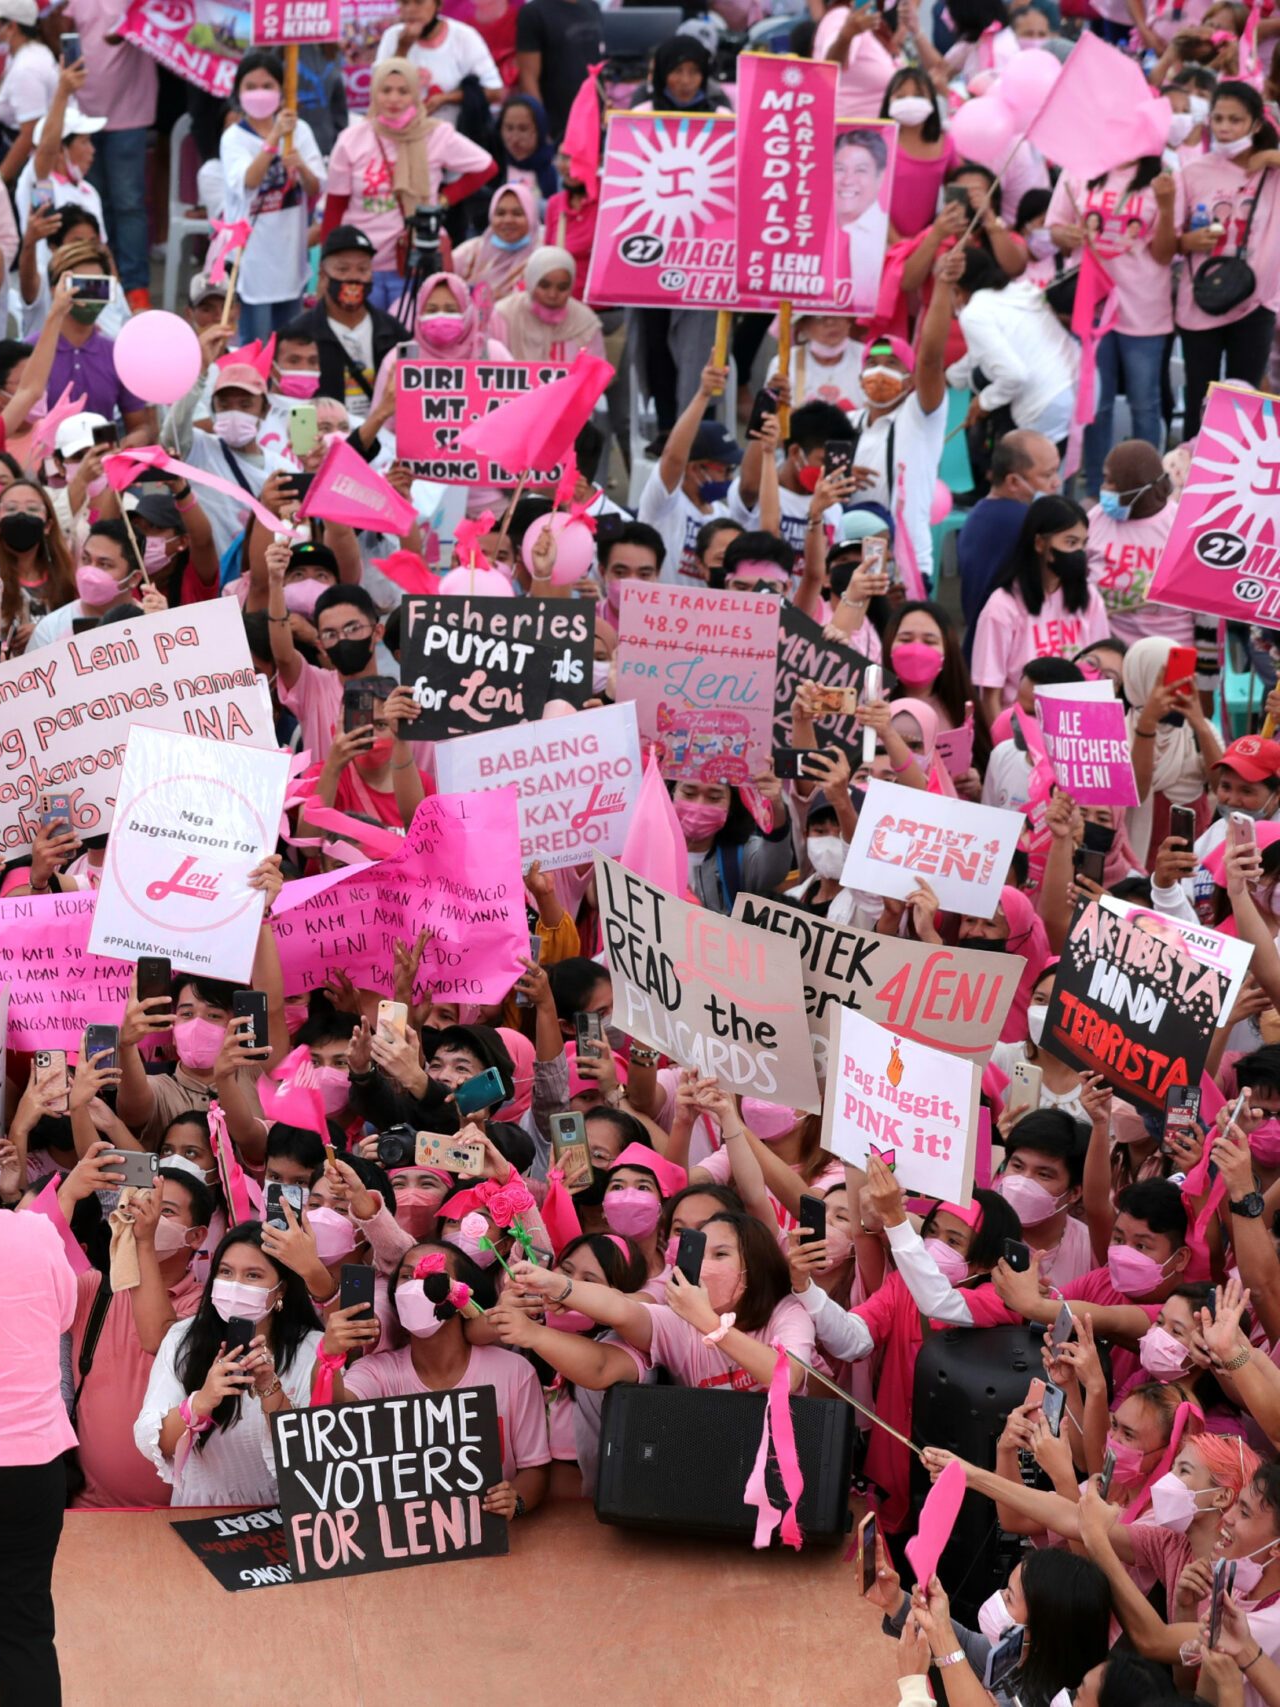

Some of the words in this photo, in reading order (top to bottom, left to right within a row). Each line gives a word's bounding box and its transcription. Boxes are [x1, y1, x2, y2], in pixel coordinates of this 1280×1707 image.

[282, 20, 330, 37] KIKO
[760, 90, 794, 245] MAGDALO
[794, 93, 816, 247] PARTYLIST
[628, 239, 658, 259] 27
[772, 252, 820, 273] LENI
[663, 272, 684, 287] 10
[747, 251, 764, 291] FOR
[770, 275, 824, 295] KIKO
[402, 366, 465, 391] DIRI
[477, 367, 532, 392] TIIL
[1203, 537, 1244, 560] 27
[623, 588, 660, 604] I'VE
[669, 593, 778, 615] TRAVELLED
[1238, 582, 1261, 598] 10
[643, 613, 689, 635] 48.9
[695, 624, 753, 640] MILES
[68, 628, 140, 676] Leni
[153, 625, 200, 665] pa
[423, 625, 535, 674] PUYAT
[412, 676, 447, 711] for
[448, 669, 524, 723] Leni
[621, 661, 659, 678] FOR
[663, 656, 761, 709] Leni
[33, 683, 169, 751] paranas
[174, 668, 258, 701] naman
[183, 701, 253, 742] INA
[1059, 710, 1082, 736] ALE
[479, 734, 599, 777] BABAENG
[1056, 736, 1131, 763] NOTCHERS
[1073, 764, 1111, 789] LENI
[179, 810, 214, 827] Mga
[524, 799, 575, 827] KAY
[571, 783, 627, 829] Leni
[129, 820, 229, 850] bagsakonon
[233, 840, 258, 854] for
[521, 820, 610, 857] BREDO!
[875, 814, 978, 849] ARTIST
[146, 855, 223, 901] Leni
[603, 861, 665, 944] LET
[103, 935, 212, 964] #PPALMAYouth4Leni
[1069, 901, 1221, 1018] AKTIBISTA
[605, 917, 682, 1012] READ
[703, 993, 778, 1049] the
[1086, 957, 1169, 1035] HINDI
[1059, 990, 1188, 1099] TERORISTA
[843, 1054, 874, 1096] Pag
[876, 1075, 961, 1128] inggit,
[843, 1091, 904, 1148] PINK
[912, 1127, 952, 1162] it!
[276, 1405, 376, 1468] FIRST
[384, 1391, 482, 1452] TIME
[294, 1446, 484, 1511] VOTERS
[291, 1508, 366, 1575] FOR
[377, 1495, 482, 1558] LENI
